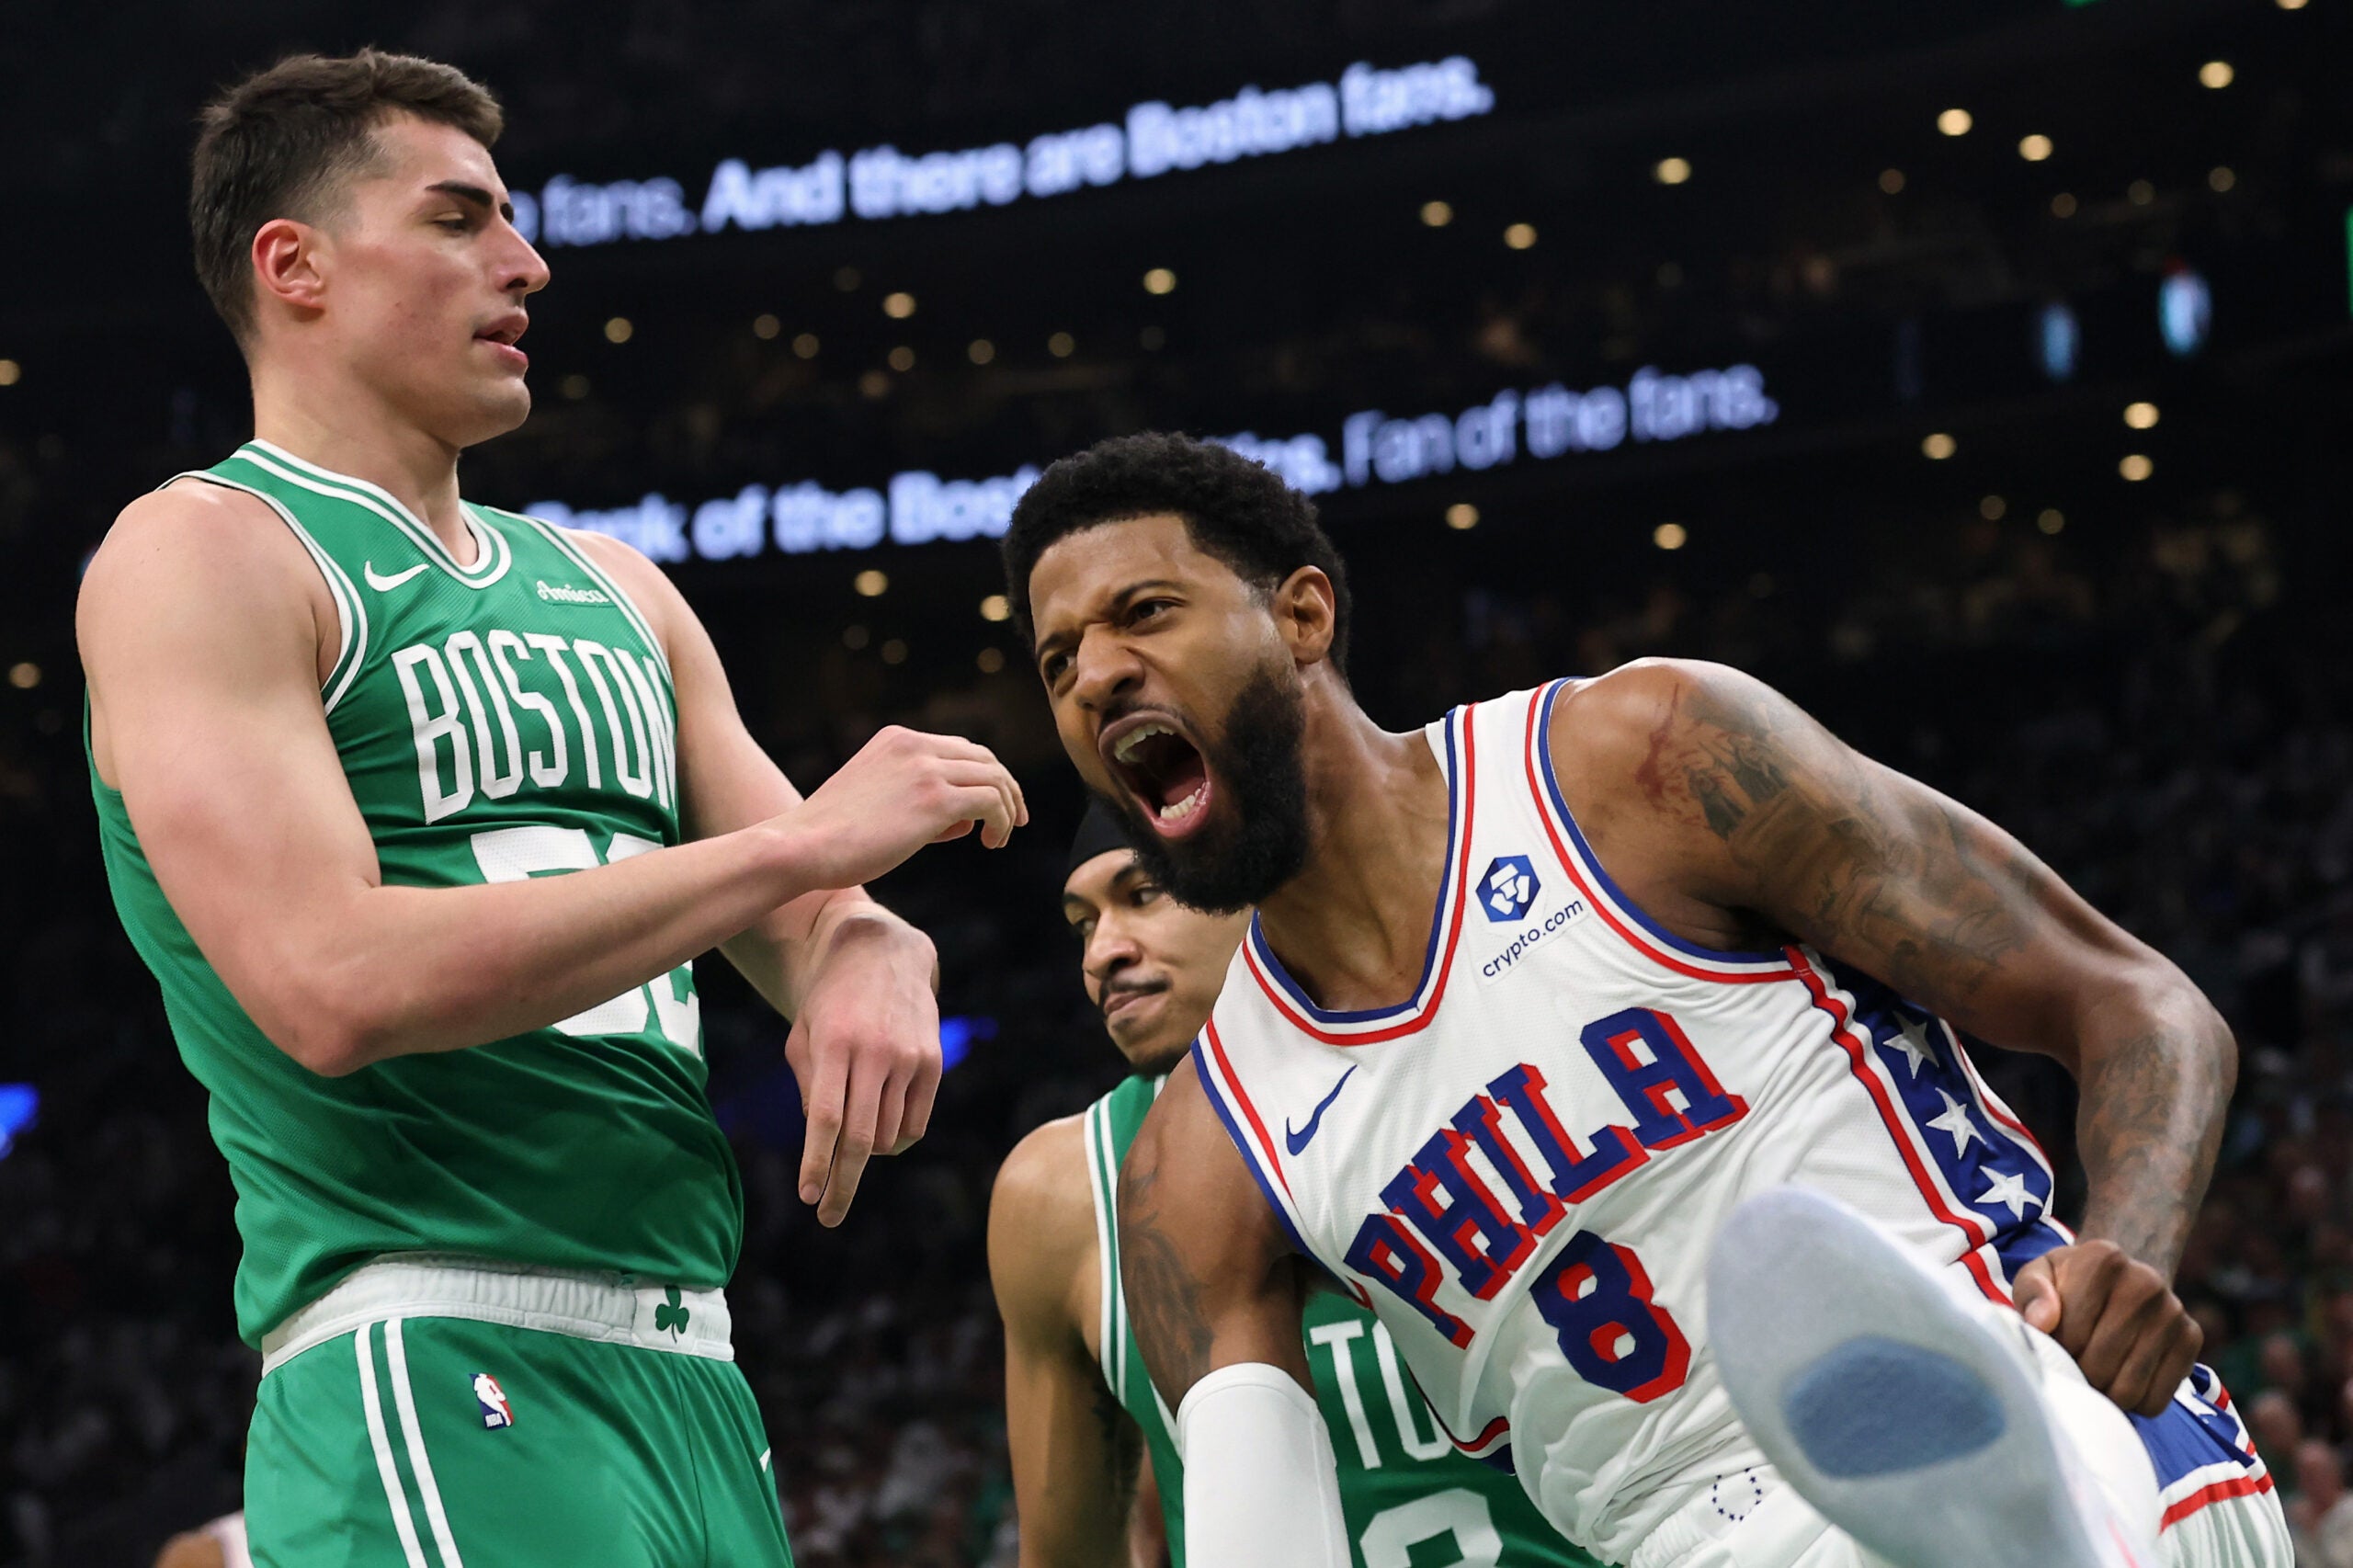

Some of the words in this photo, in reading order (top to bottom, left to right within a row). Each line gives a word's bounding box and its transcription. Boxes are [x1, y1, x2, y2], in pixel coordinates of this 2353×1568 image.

[701, 148, 846, 233] And
[849, 143, 1022, 219] there
[1024, 122, 1124, 197] are
[1126, 84, 1338, 179] Boston
[1340, 55, 1495, 138] fans.
[693, 483, 769, 561] of
[773, 479, 885, 554] the
[1343, 409, 1455, 488] Fan
[1456, 389, 1519, 471] of
[1525, 382, 1627, 460] the
[1630, 365, 1779, 443] fans.
[391, 630, 679, 826] BOSTON
[1483, 900, 1584, 977] crypto.com
[1344, 1007, 1750, 1350] PHILA
[1529, 1230, 1691, 1404] 8
